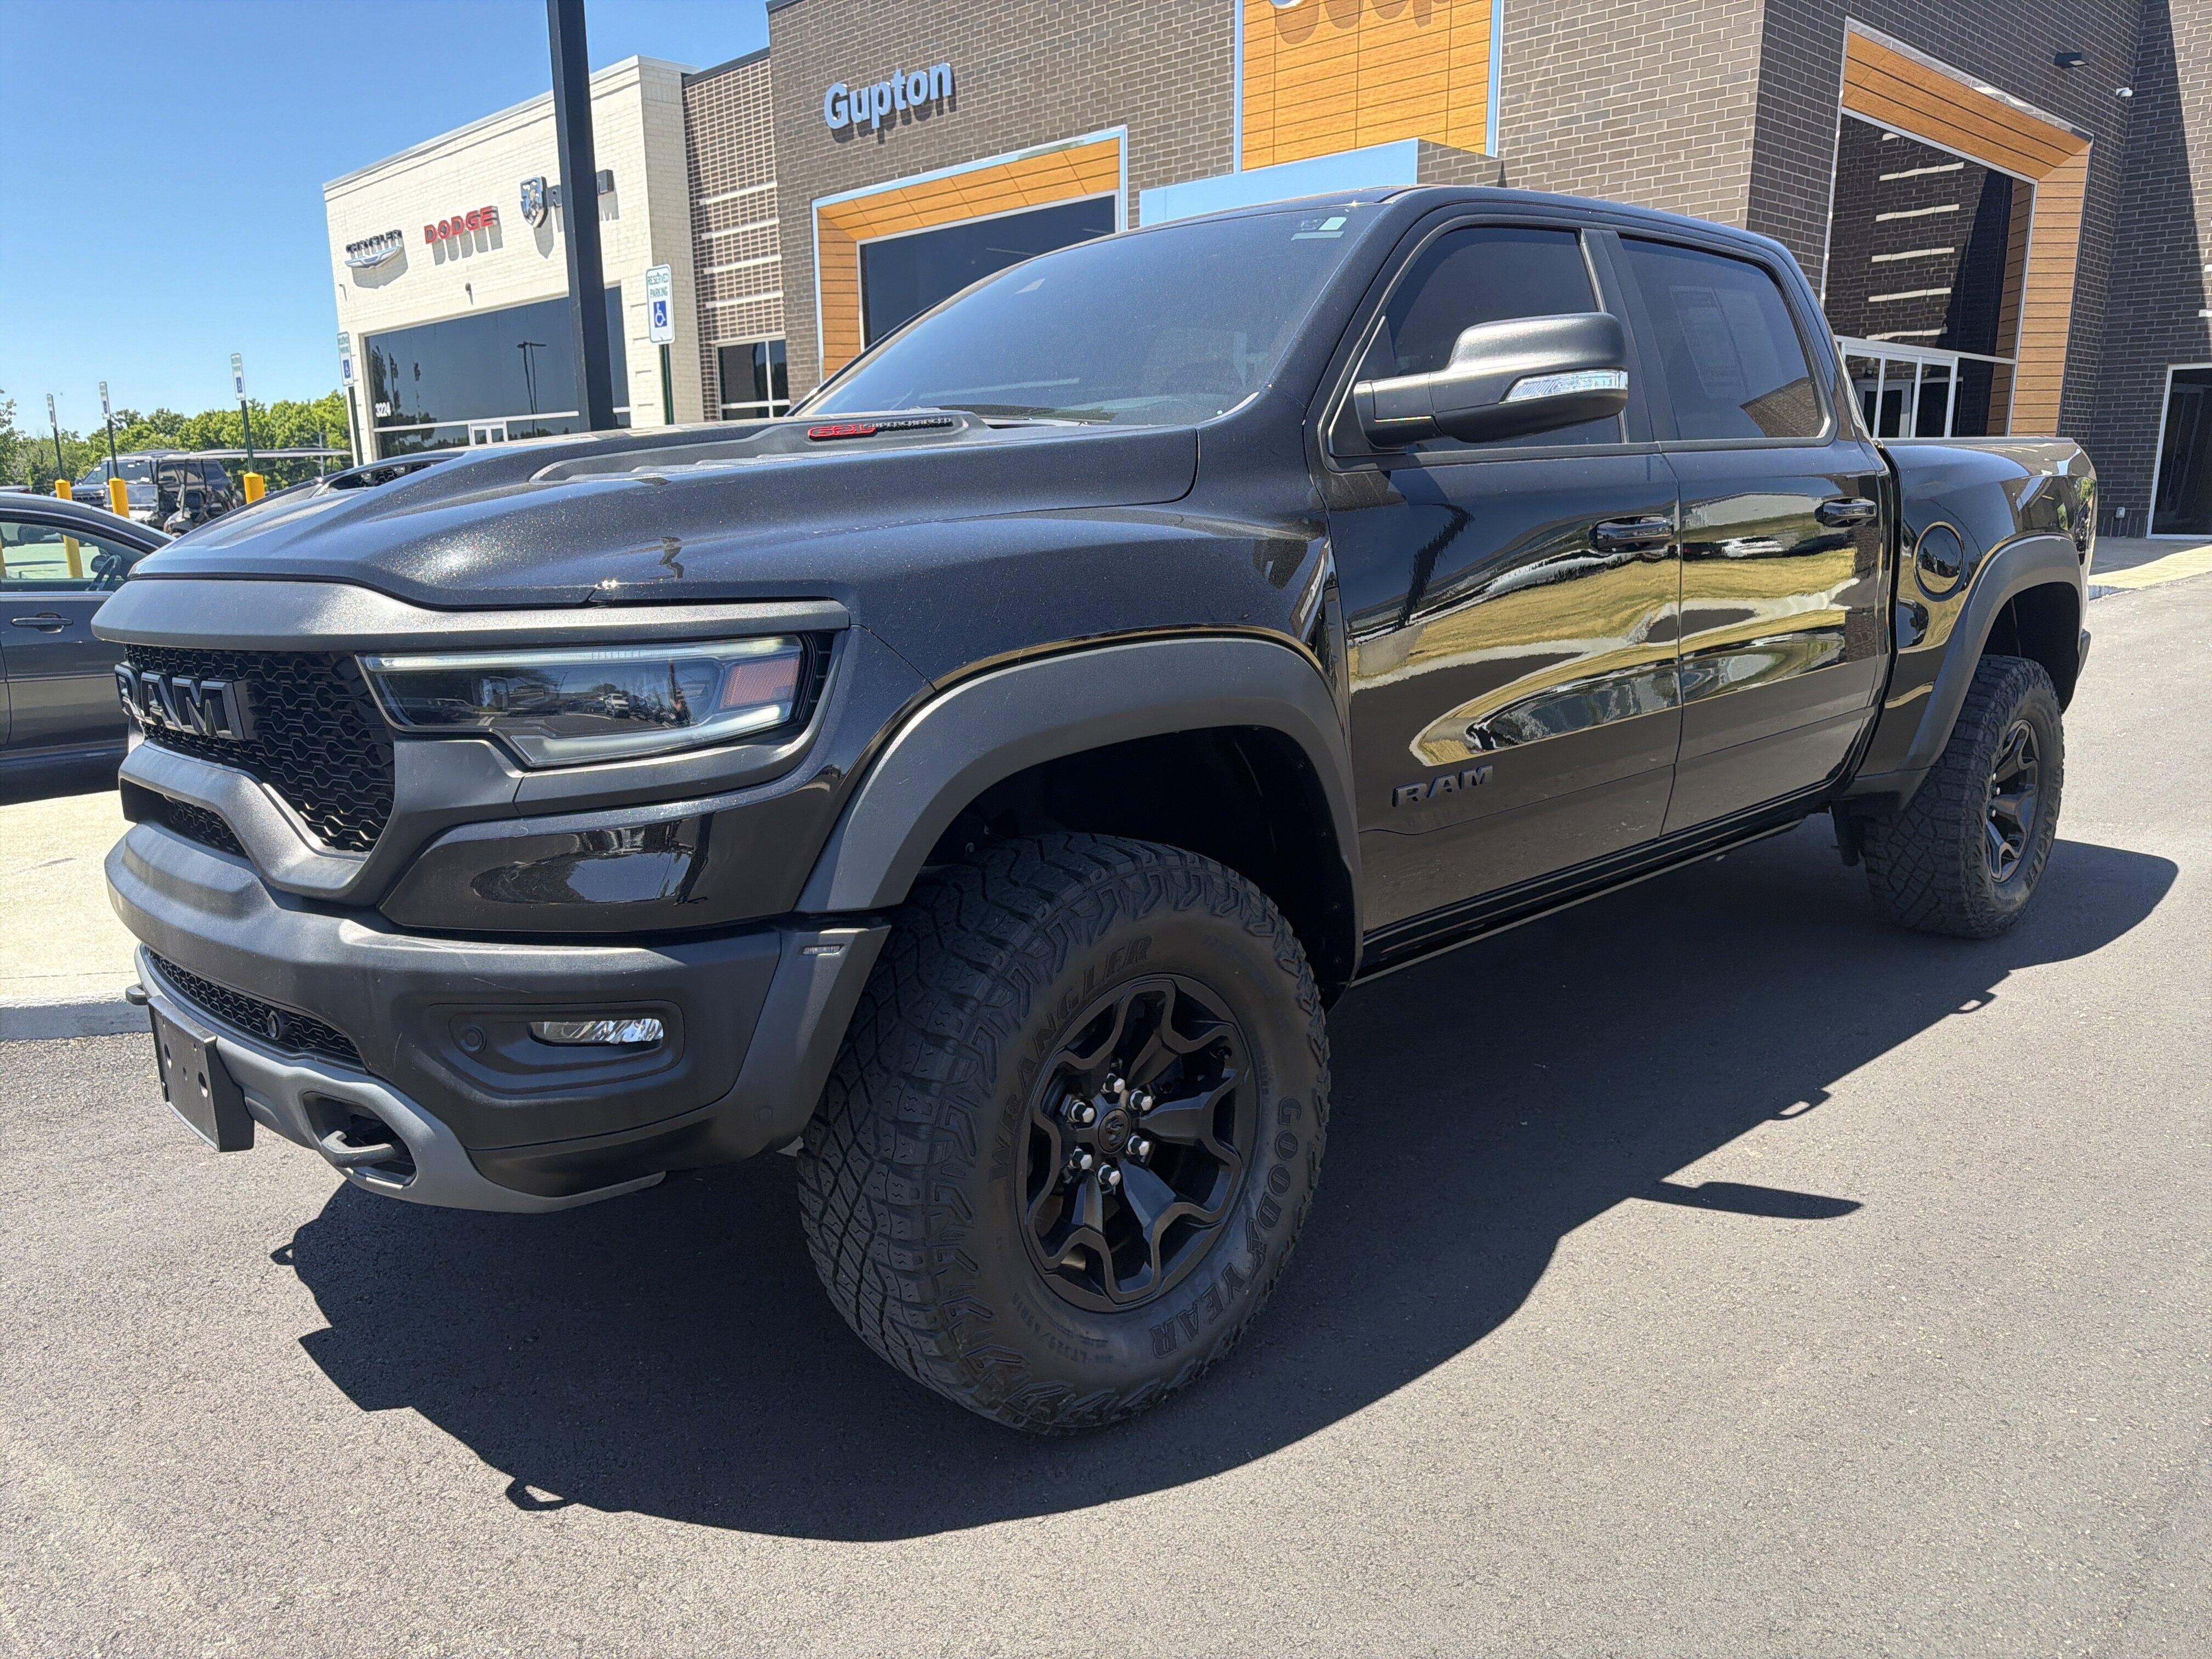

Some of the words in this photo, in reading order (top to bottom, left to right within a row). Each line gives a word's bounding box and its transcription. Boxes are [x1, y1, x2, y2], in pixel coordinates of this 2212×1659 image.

[824, 62, 953, 129] Gupton
[424, 206, 497, 245] DODGE
[375, 401, 391, 417] 3224
[114, 662, 245, 741] RAM
[1392, 764, 1493, 806] RAM
[989, 936, 1153, 1182] WRANGLER
